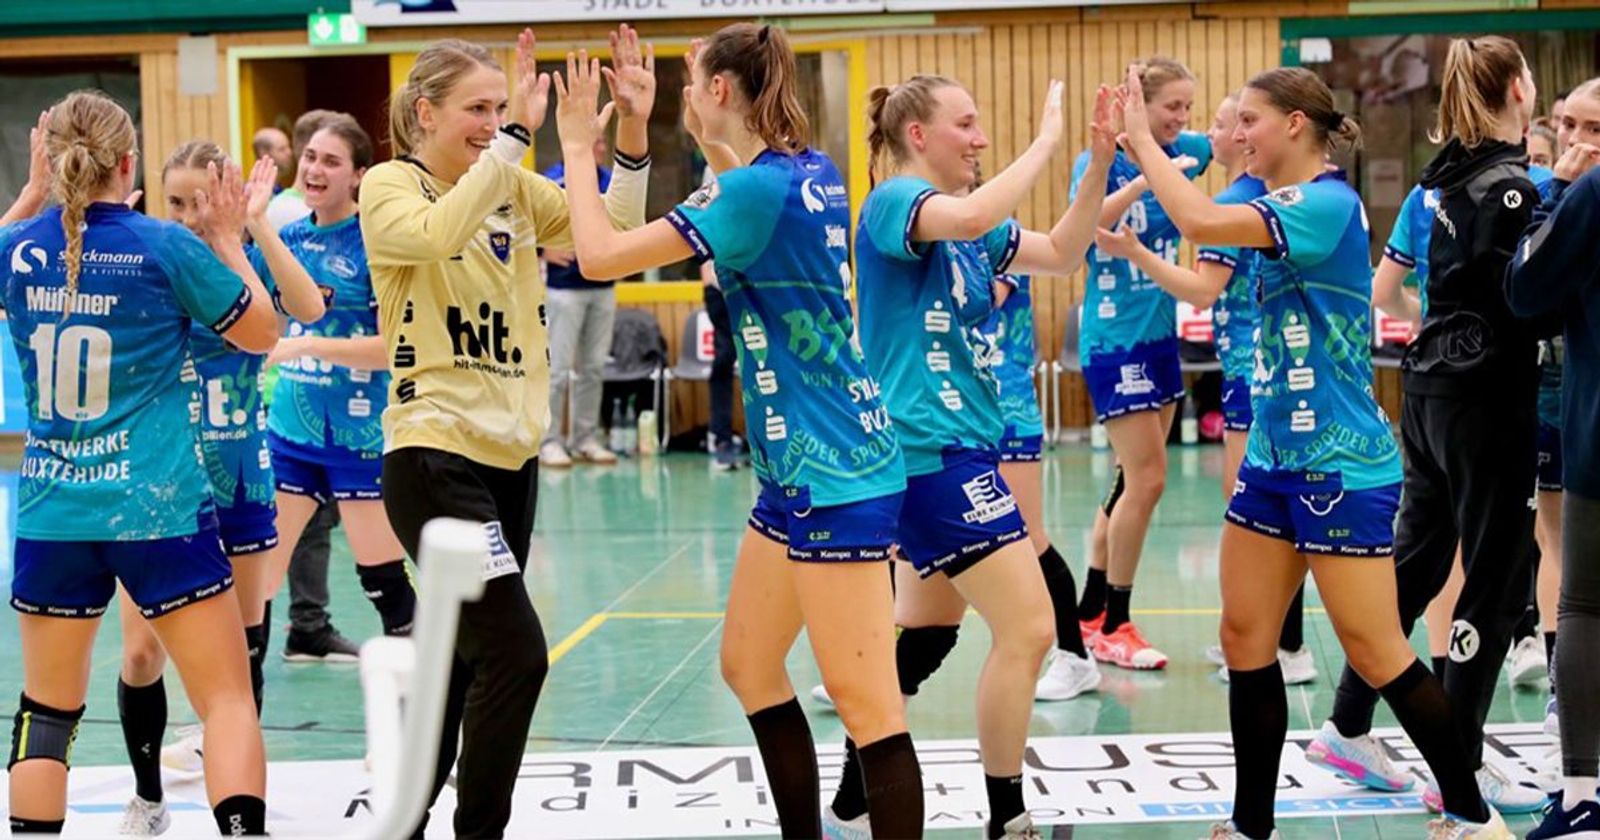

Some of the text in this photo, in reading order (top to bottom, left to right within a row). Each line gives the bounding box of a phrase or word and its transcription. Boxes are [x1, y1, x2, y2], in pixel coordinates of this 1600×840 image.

[57, 248, 144, 265] sckmann
[447, 302, 522, 364] hit.
[29, 323, 112, 420] 10
[820, 550, 851, 561] Kempa
